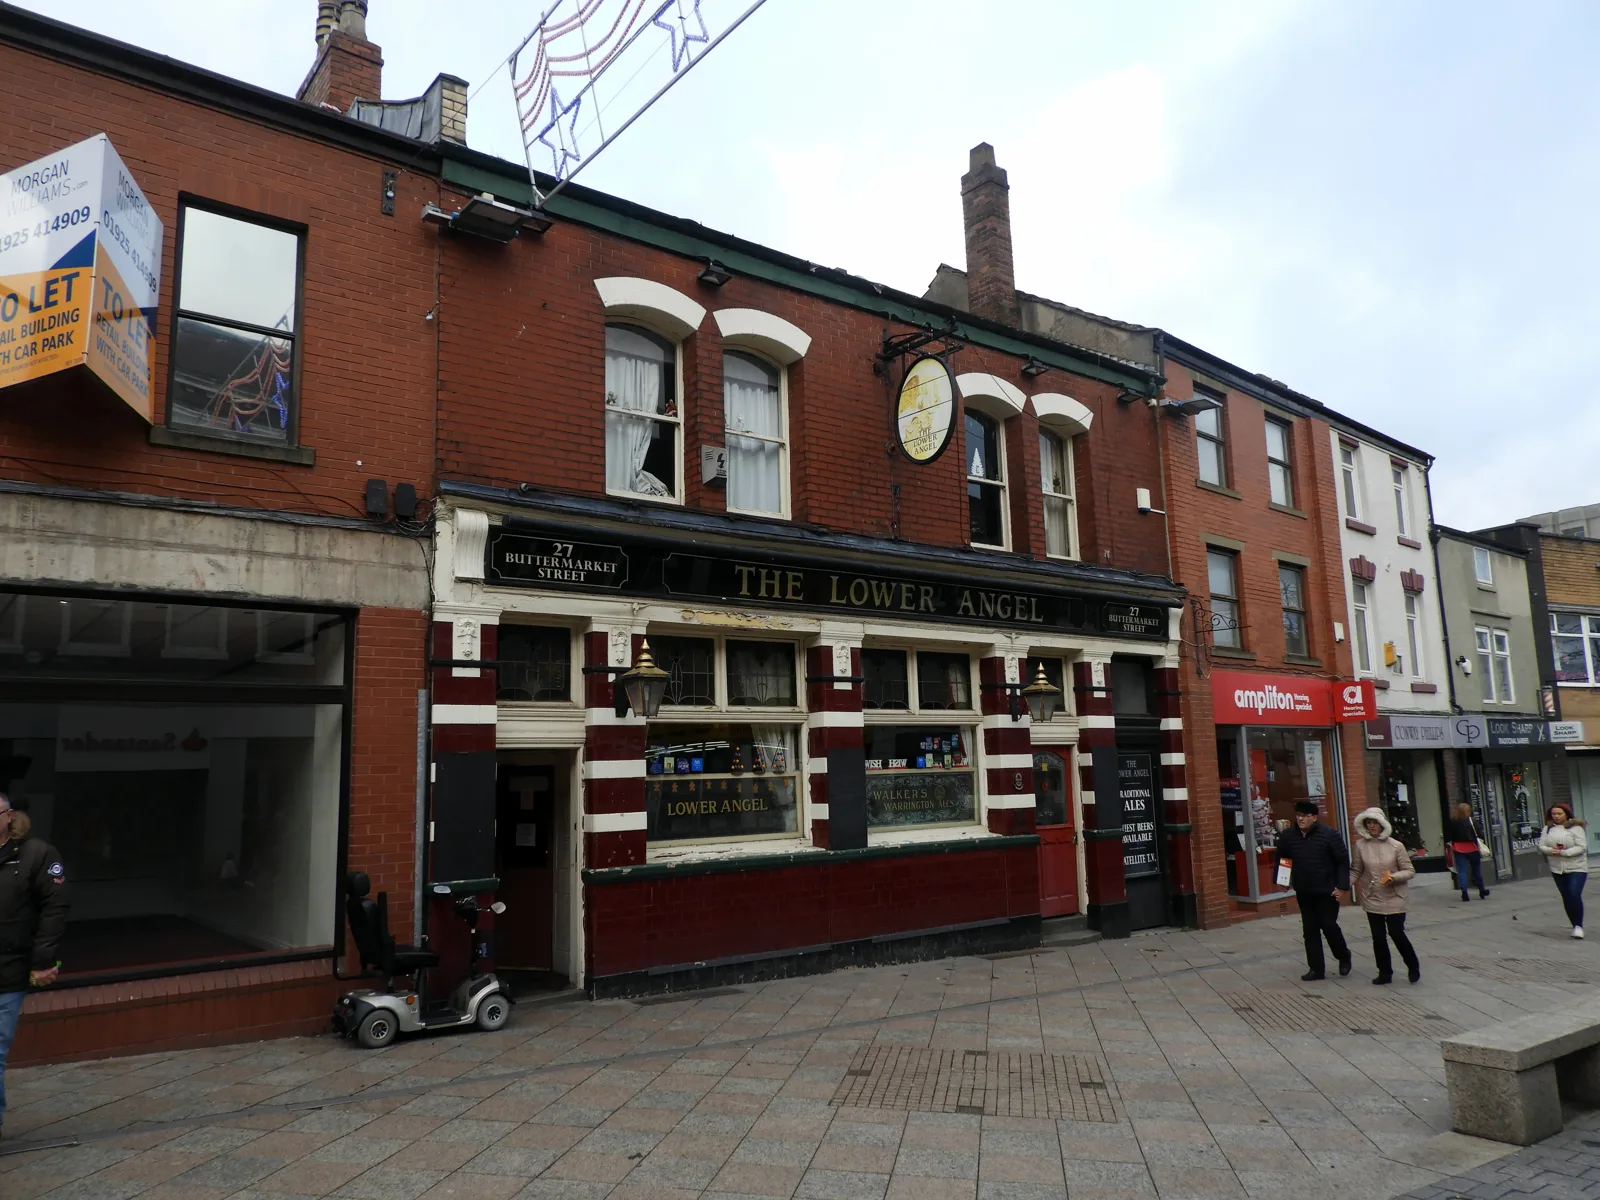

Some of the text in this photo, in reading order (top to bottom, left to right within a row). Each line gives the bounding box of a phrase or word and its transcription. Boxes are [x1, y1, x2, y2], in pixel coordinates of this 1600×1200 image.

[11, 159, 69, 195] MORGAN
[32, 205, 91, 239] 414909
[104, 209, 157, 293] 01925 414909
[0, 271, 80, 323] O LET
[20, 307, 80, 340] BUILDING
[102, 276, 152, 357] TO LET
[13, 340, 39, 363] CAR
[40, 329, 75, 354] PARK
[96, 311, 121, 349] RETAIL
[122, 339, 151, 382] BUILDING
[97, 334, 116, 367] WITH
[117, 356, 131, 380] CAR
[132, 371, 150, 399] PARK
[919, 425, 932, 437] THE
[913, 433, 938, 449] LOWER
[914, 443, 938, 456] ANGEL
[552, 542, 574, 558] 27
[505, 552, 618, 574] BUTTERMARKET
[538, 567, 587, 582] STREET
[735, 564, 1044, 623] THE LOWER ANGEL
[1129, 606, 1139, 617] 27
[1108, 614, 1159, 627] BUTTERMARKET
[1123, 623, 1146, 633] STREET
[1234, 684, 1295, 715] amplifon
[1490, 721, 1533, 734] LOOK SHARP
[1126, 760, 1137, 768] THE
[1133, 769, 1149, 777] ANGEL
[1120, 789, 1151, 799] RADITIONAL
[667, 798, 768, 816] LOWER ANGEL
[883, 800, 934, 811] WARRINGTON
[1124, 799, 1146, 811] ALES
[1137, 821, 1154, 831] BEERS
[1122, 832, 1153, 844] AVAILABLE
[1124, 854, 1146, 865] ATELLITE
